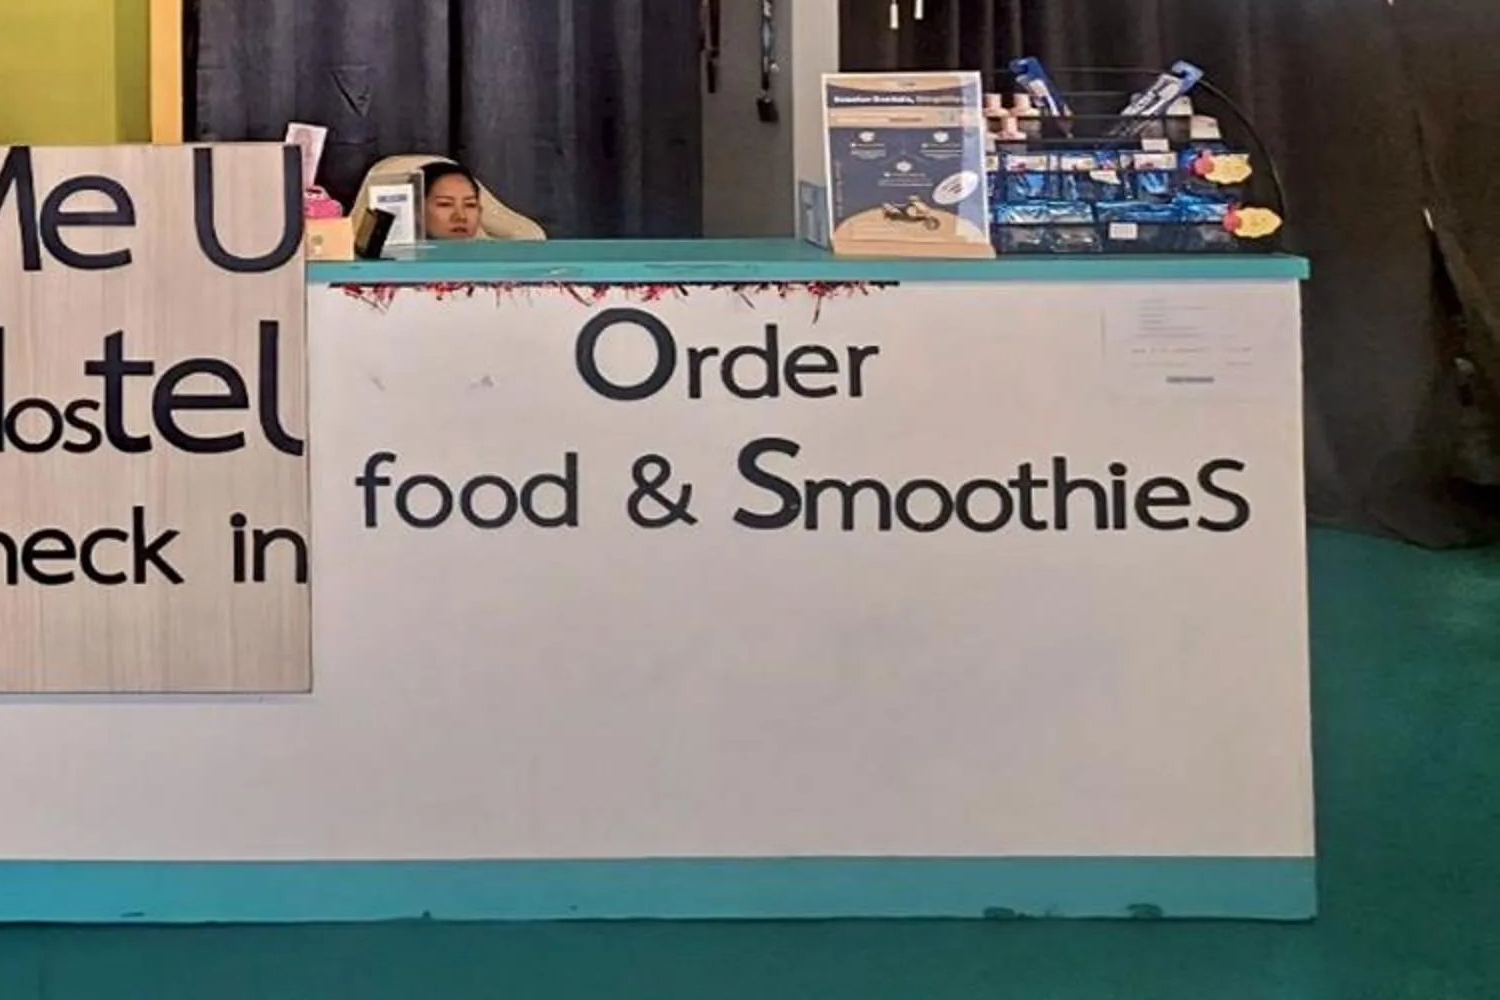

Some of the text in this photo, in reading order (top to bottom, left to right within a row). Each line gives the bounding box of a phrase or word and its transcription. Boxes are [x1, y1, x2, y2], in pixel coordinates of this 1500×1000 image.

[193, 146, 305, 273] U
[575, 308, 880, 400] Order
[355, 452, 579, 529] food
[627, 454, 698, 529] &
[229, 512, 309, 584] in
